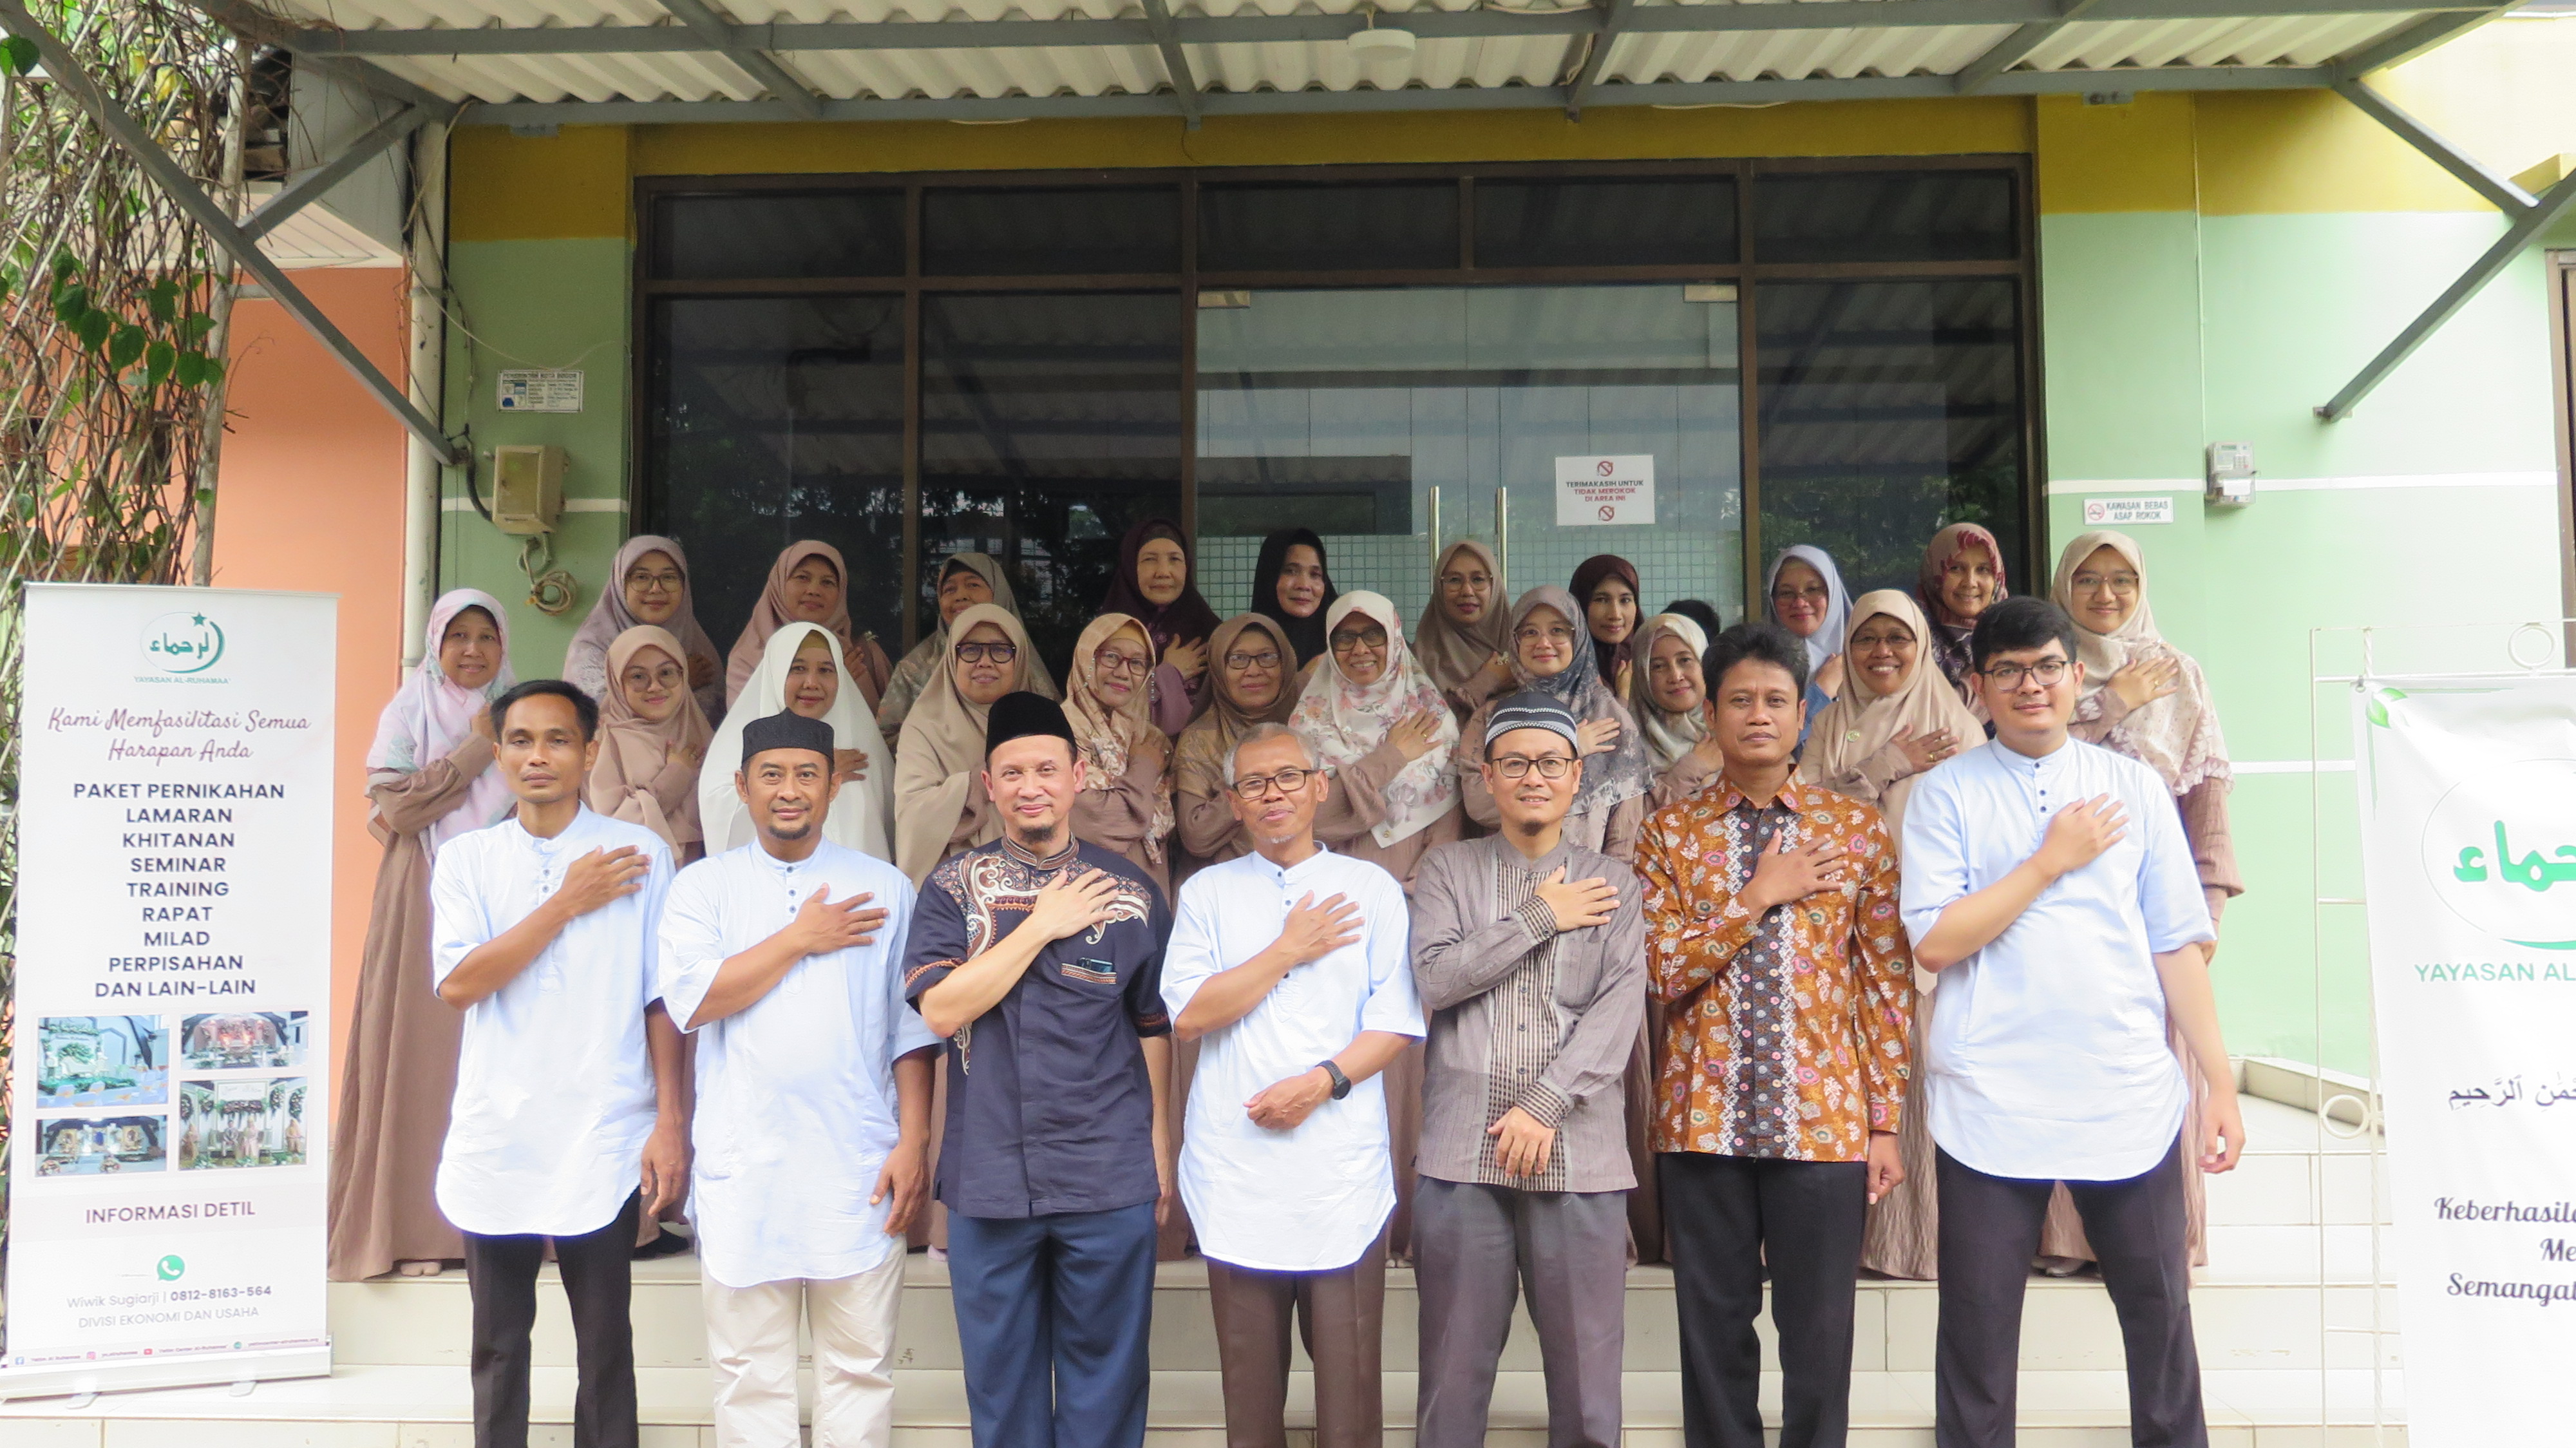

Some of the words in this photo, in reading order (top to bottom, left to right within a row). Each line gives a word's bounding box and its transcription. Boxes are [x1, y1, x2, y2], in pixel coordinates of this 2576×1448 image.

[2107, 501, 2141, 510] KAWASAN
[2145, 500, 2168, 510] BEBAS
[2114, 511, 2133, 520] ASAP
[2136, 511, 2161, 520] ROKOK
[47, 707, 106, 733] Kami
[104, 708, 242, 738] Memfasilitasi
[245, 709, 312, 733] Semua
[108, 738, 197, 767] Harapan
[198, 738, 254, 763] Anda
[73, 783, 142, 798] PAKET
[147, 783, 284, 799] PERNIKAHAN
[126, 808, 232, 823] LAMARAN
[123, 833, 234, 848] KHITANAN
[131, 857, 226, 873] SEMINAR
[126, 882, 229, 897] TRAINING
[142, 906, 213, 922] RAPAT
[144, 931, 210, 947] MILAD
[109, 955, 243, 972] PERPISAHAN
[2414, 963, 2535, 982] YAYASAN
[95, 982, 142, 998] DAN
[148, 979, 256, 996] LAIN-LAIN
[86, 1204, 198, 1224] INFORMASI
[204, 1201, 256, 1218] DETIL
[2434, 1197, 2576, 1223] Keberhasil
[67, 1295, 106, 1308] Wiwik
[170, 1286, 272, 1301] 0812-8163-564
[78, 1316, 116, 1329] DIVISI
[119, 1311, 180, 1326] EKONOMI
[184, 1309, 212, 1321] DAN
[216, 1306, 259, 1319] USAHA
